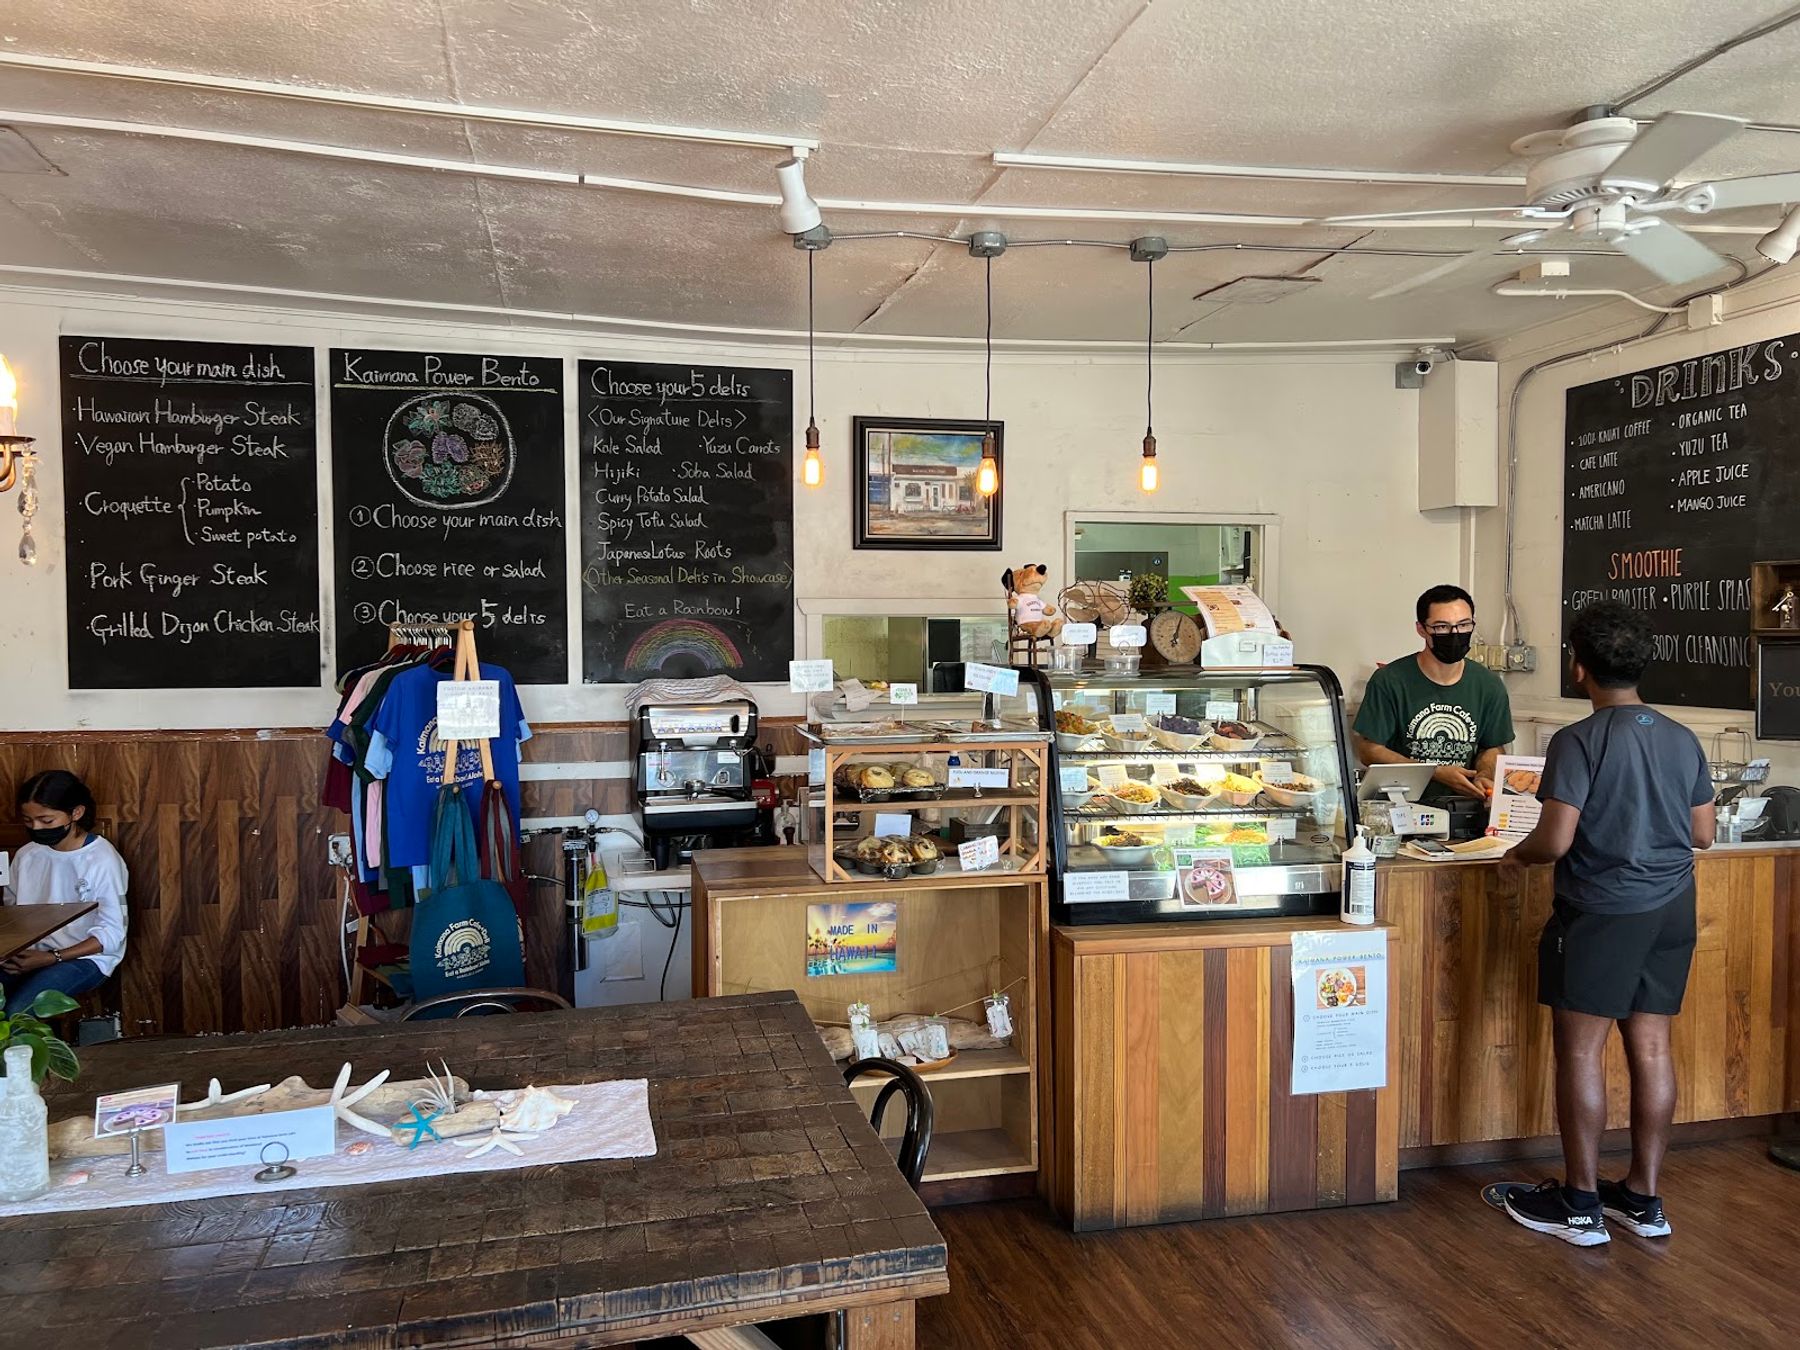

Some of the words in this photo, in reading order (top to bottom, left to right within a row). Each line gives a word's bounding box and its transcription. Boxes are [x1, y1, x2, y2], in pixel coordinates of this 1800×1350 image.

[78, 342, 150, 374] Choose
[154, 356, 194, 388] your
[197, 362, 236, 378] main
[242, 352, 285, 379] dish
[344, 352, 419, 384] Kaimana
[424, 356, 474, 385] Power
[482, 358, 540, 386] Bento
[1631, 341, 1784, 408] DRINKS
[591, 367, 652, 396] Choose
[655, 379, 691, 407] your
[690, 369, 705, 397] 5
[709, 373, 750, 397] delis
[155, 398, 240, 436] Hamburger
[244, 401, 301, 426] Steak
[628, 408, 690, 436] Signature
[1678, 408, 1722, 430] ORGANIC
[1729, 402, 1748, 420] TEA
[1624, 420, 1652, 438] COFFEE
[78, 432, 134, 466] Vegan
[140, 432, 224, 464] Hamburger
[231, 434, 289, 459] Steak
[593, 435, 620, 456] Kale
[625, 435, 663, 456] Salad
[702, 436, 732, 455] Yuzu
[735, 436, 780, 454] Carrots
[1679, 438, 1704, 457] YUZU
[1711, 432, 1728, 452] TEA
[594, 461, 640, 484] Hijiki
[716, 462, 756, 481] Salad
[1580, 454, 1597, 470] CAFE
[1599, 452, 1618, 468] LATTE
[196, 472, 252, 492] Potato
[1678, 468, 1710, 488] APPLE
[1716, 464, 1750, 483] JUICE
[595, 488, 632, 512] Curry
[637, 486, 670, 504] Potato
[673, 486, 710, 506] Salad
[1579, 480, 1625, 500] AMERICANO
[84, 491, 174, 520] Croquette
[198, 498, 262, 522] Pumpkin
[1677, 496, 1714, 512] MANGO
[1717, 494, 1746, 509] JUICE
[373, 504, 437, 529] Choose
[442, 514, 476, 542] your
[480, 512, 519, 528] main
[522, 508, 563, 528] dish
[598, 512, 633, 540] Spicy
[636, 512, 664, 527] Tofu
[670, 512, 709, 528] Salad
[1574, 514, 1604, 531] MATCHA
[1608, 510, 1632, 529] LATTE
[200, 526, 242, 543] Sweet
[247, 528, 297, 549] potato
[651, 540, 686, 559] Lotus
[696, 540, 732, 560] Roots
[376, 553, 438, 578] Choose
[443, 562, 476, 576] rice
[483, 565, 500, 576] or
[502, 559, 546, 579] salad
[626, 566, 673, 585] Seasonal
[712, 572, 726, 584] in
[1608, 548, 1683, 580] SMOOTHIE
[90, 562, 132, 589] Pork
[140, 563, 200, 598] Ginger
[209, 562, 268, 586] Steak
[624, 603, 652, 618] Eat
[659, 606, 668, 615] a
[674, 596, 741, 615] Rainbow!
[1670, 581, 1710, 610] PURPLE
[378, 599, 438, 626] Choose
[480, 598, 498, 628] 5
[502, 605, 546, 625] delis
[90, 612, 154, 646] Grilled
[214, 610, 275, 634] Chicken
[276, 610, 320, 633] Steak
[1430, 703, 1452, 712] Farm
[830, 924, 854, 936] MADE
[867, 924, 878, 934] IN
[1567, 1216, 1594, 1226] HOKA
